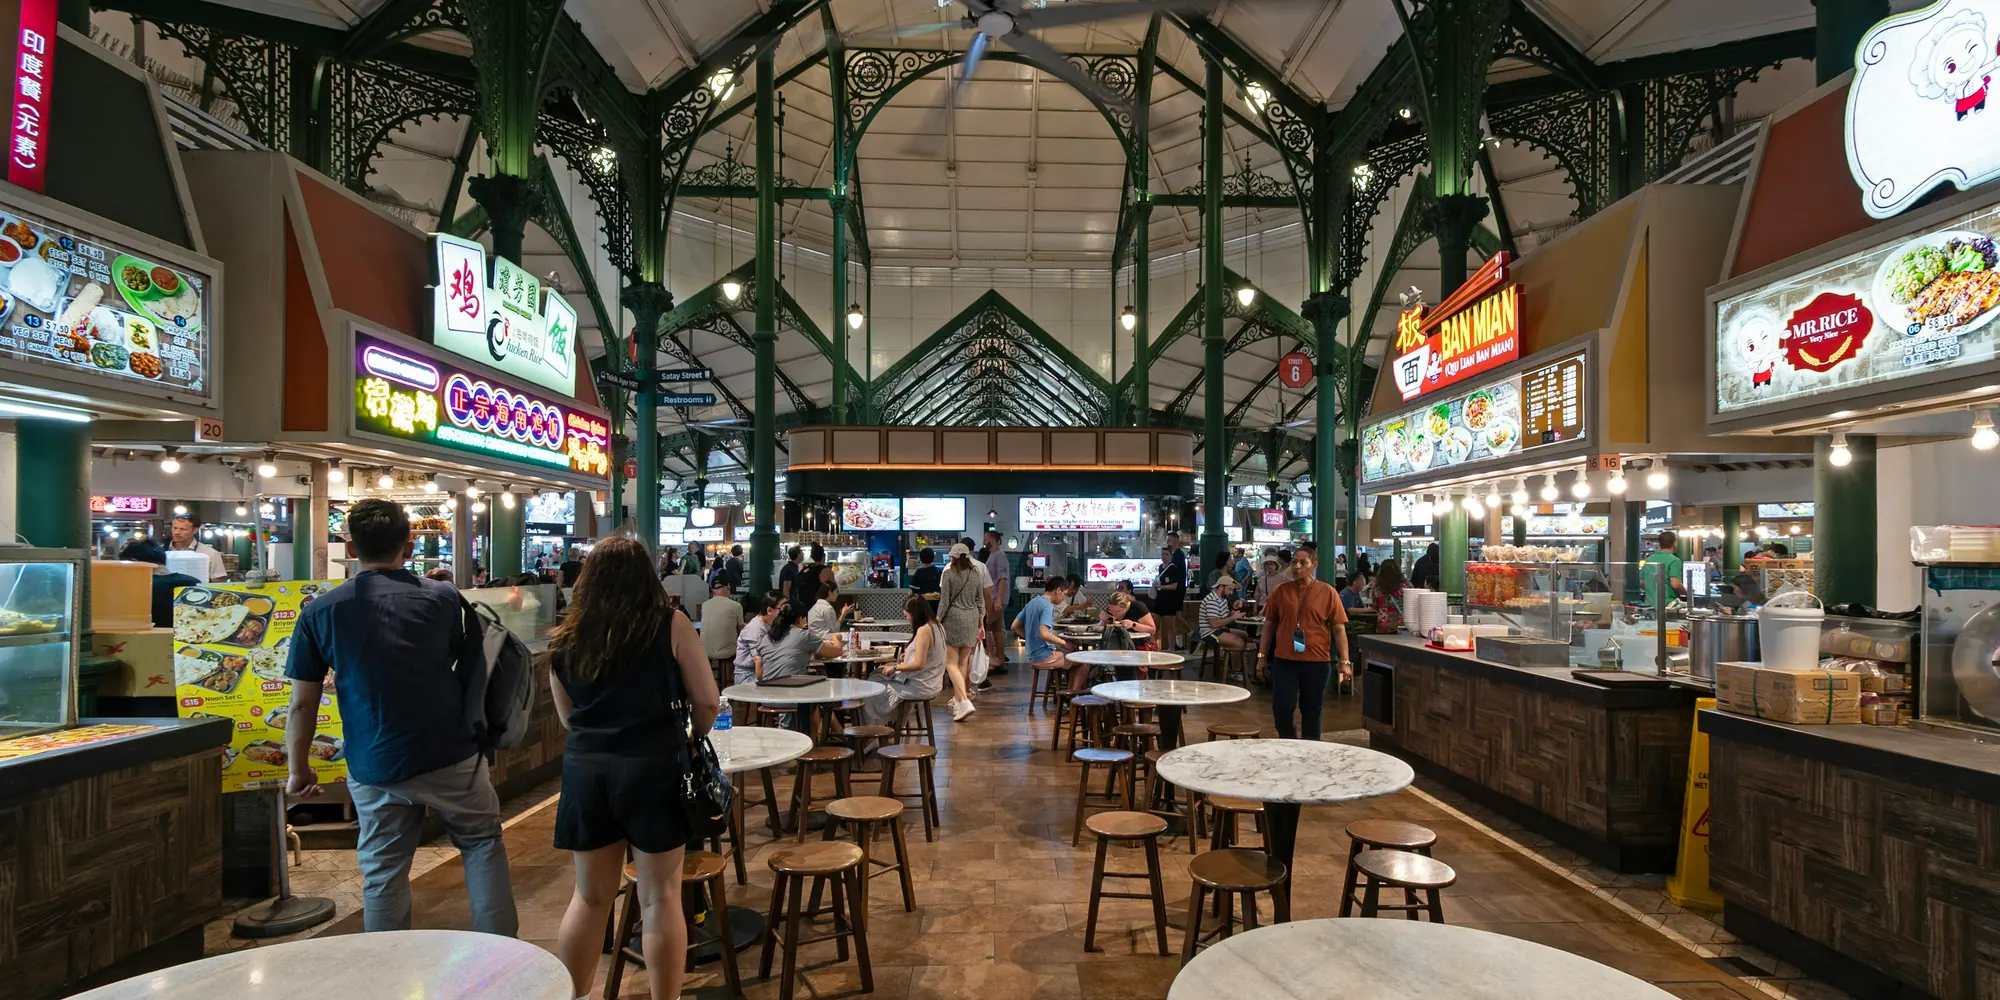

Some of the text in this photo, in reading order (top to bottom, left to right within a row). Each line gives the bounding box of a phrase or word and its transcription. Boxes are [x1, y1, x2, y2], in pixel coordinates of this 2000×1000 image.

[62, 239, 103, 260] 12 $8.50
[72, 255, 87, 267] SET
[89, 260, 110, 275] MEAL
[450, 258, 480, 318] 鸡
[26, 316, 70, 334] 13 $7.50
[175, 316, 185, 327] 14
[1396, 305, 1425, 354] 板
[1441, 285, 1515, 361] BAN MIAN
[1793, 308, 1858, 340] MR.RICE
[1908, 313, 1954, 334] 06 $8.50
[12, 326, 74, 348] VEG SET MEAL
[1809, 331, 1839, 344] Very Nice
[661, 371, 702, 380] Satay Street
[1291, 365, 1300, 382] 6
[1402, 356, 1420, 387] 面
[663, 396, 704, 404] Restrooms
[203, 423, 221, 437] 20
[1588, 458, 1597, 469] 16
[1604, 457, 1617, 468] 16
[274, 611, 295, 619] $12.5
[262, 683, 283, 691] $12.5
[184, 698, 199, 706] $15
